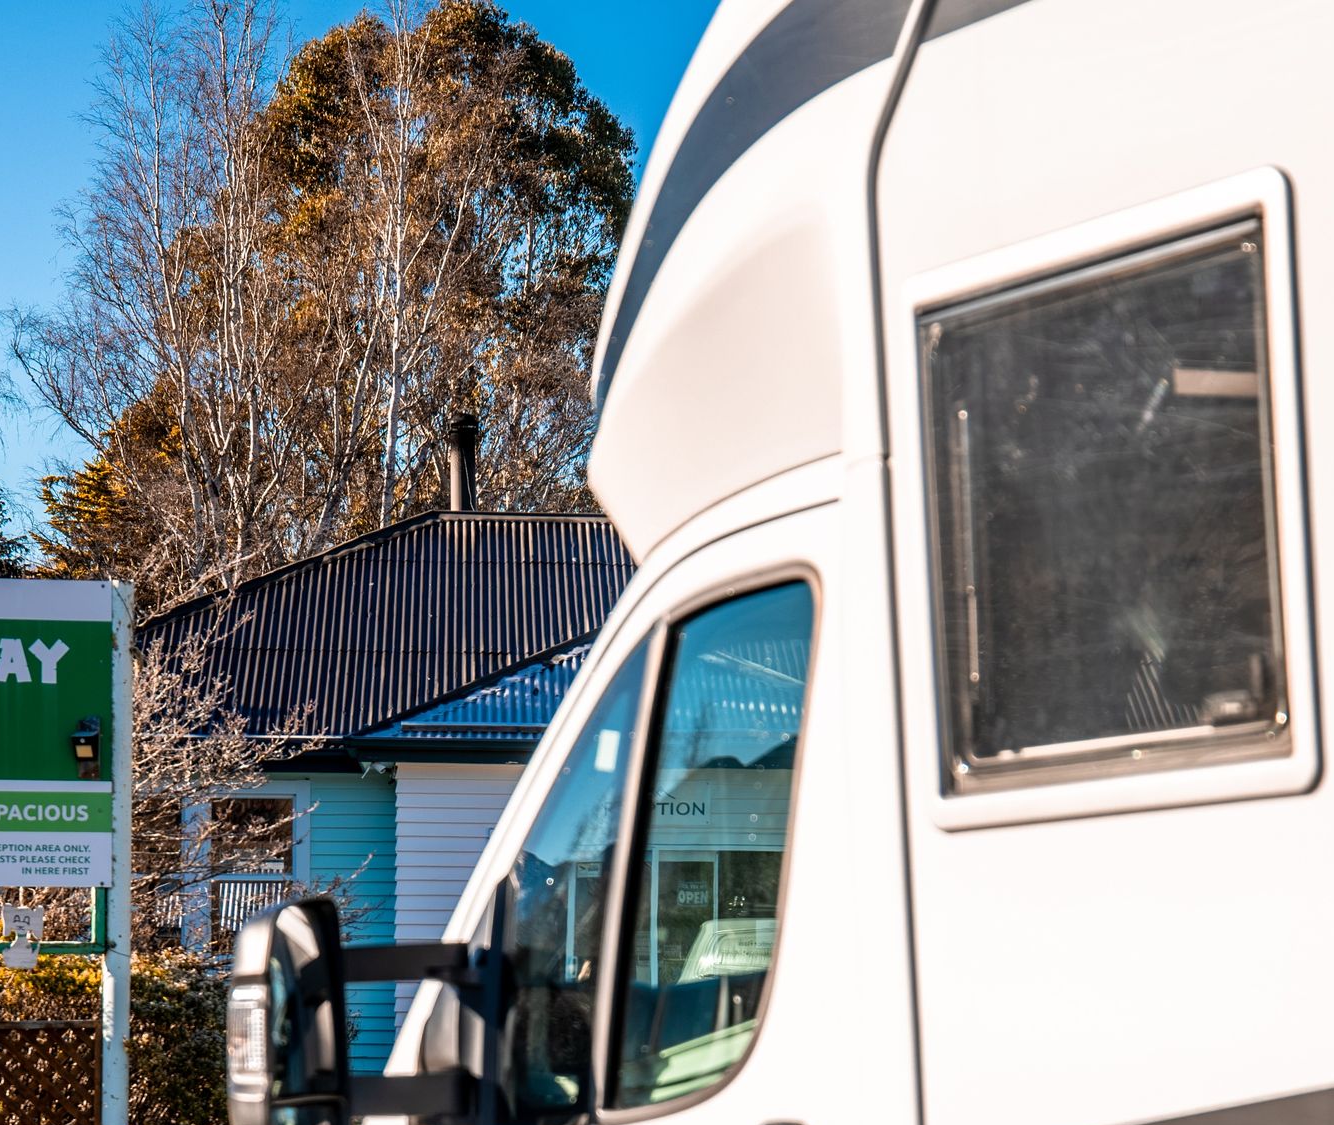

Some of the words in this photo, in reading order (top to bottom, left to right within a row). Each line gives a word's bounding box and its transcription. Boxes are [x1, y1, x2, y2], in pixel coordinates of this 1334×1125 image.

[34, 844, 61, 852] AREA
[63, 844, 91, 853] ONLY.
[19, 855, 56, 864] PLEASE
[58, 855, 91, 864] CHECK
[21, 866, 32, 875] IN
[34, 867, 60, 875] HERE
[62, 867, 90, 876] FIRST
[677, 890, 709, 905] OPEN
